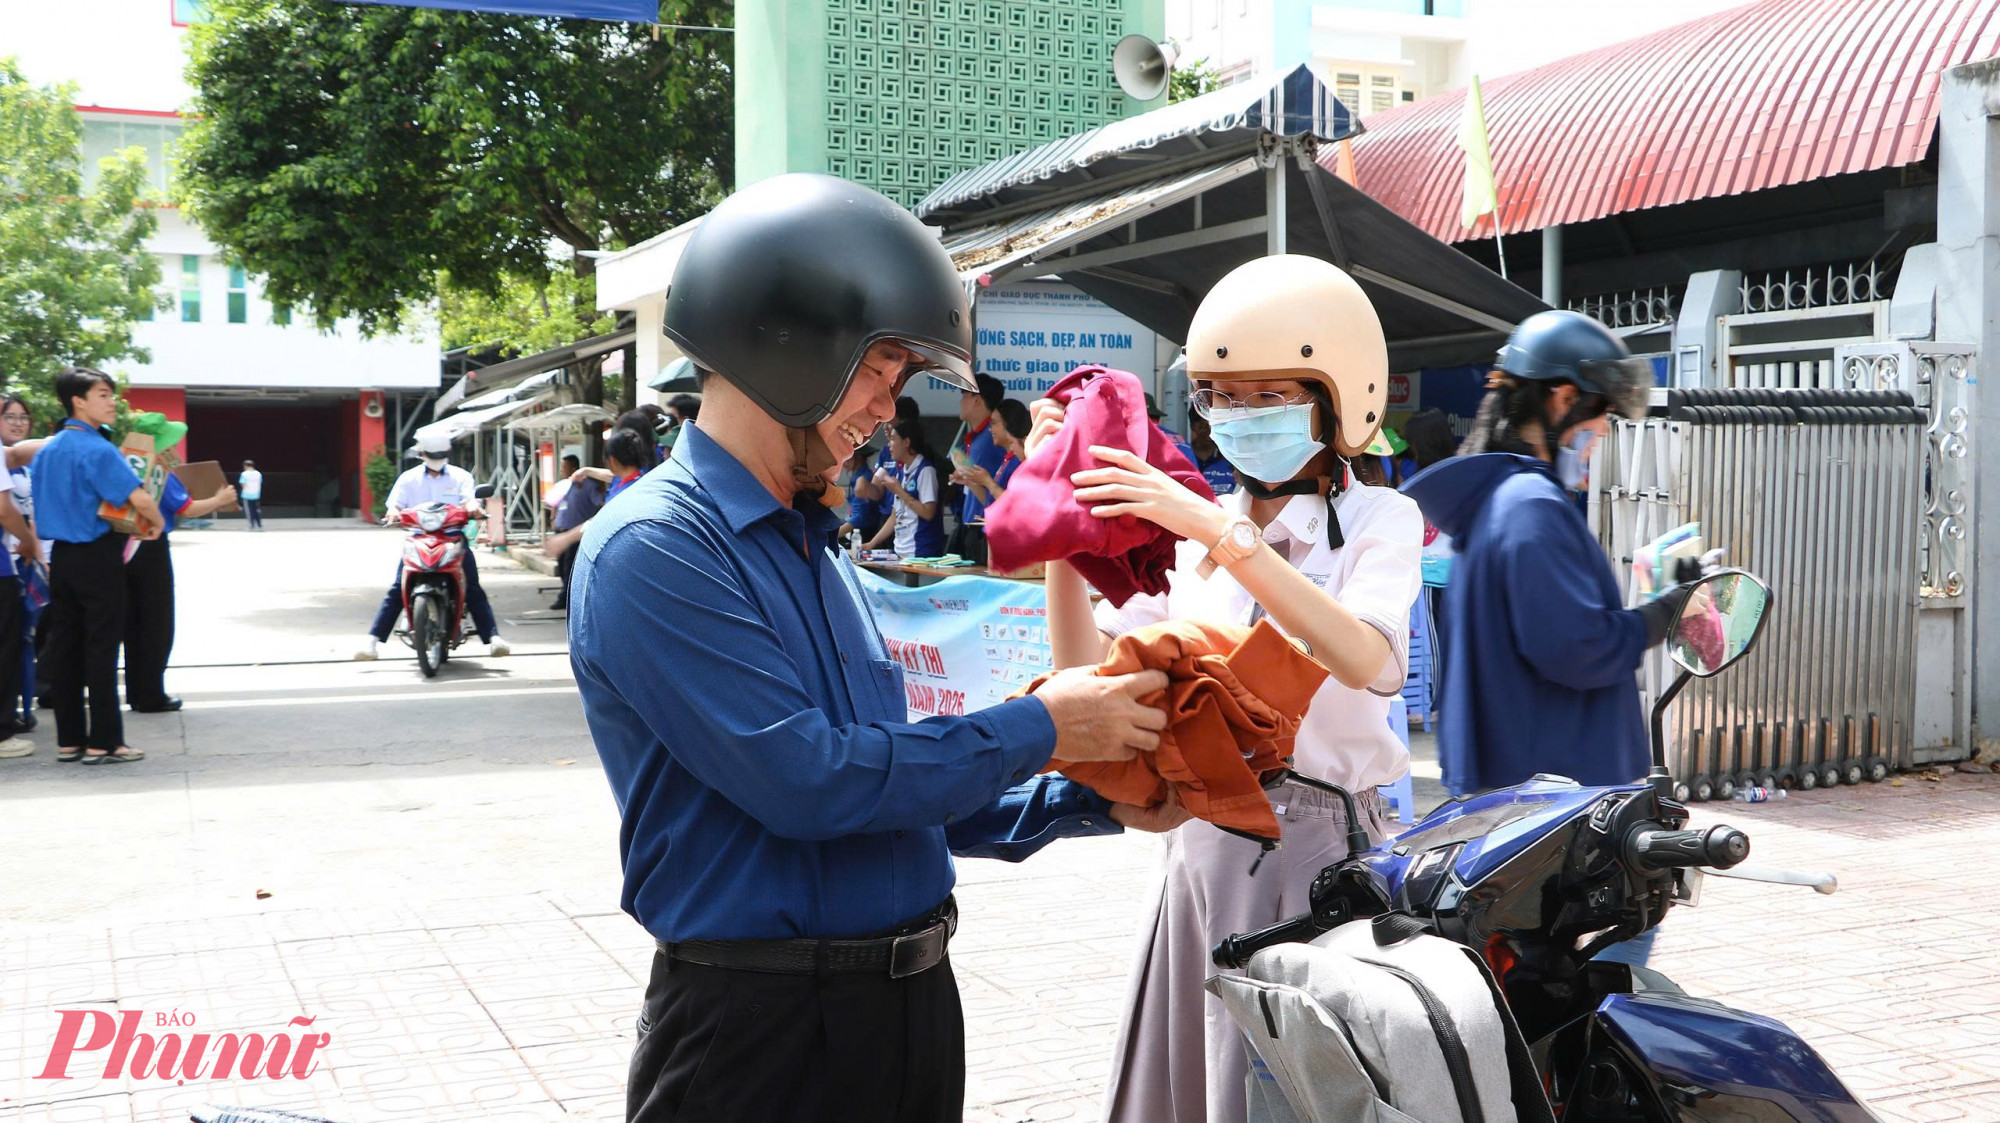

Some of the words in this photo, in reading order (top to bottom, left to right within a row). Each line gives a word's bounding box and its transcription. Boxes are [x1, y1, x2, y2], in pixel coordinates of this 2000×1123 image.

[1010, 330, 1048, 349] SẠCH,
[1079, 333, 1096, 348] AN
[1099, 331, 1132, 349] TOÀN
[986, 358, 1021, 372] thức
[1026, 359, 1060, 373] giao
[920, 644, 946, 675] THI
[937, 687, 966, 716] 2026
